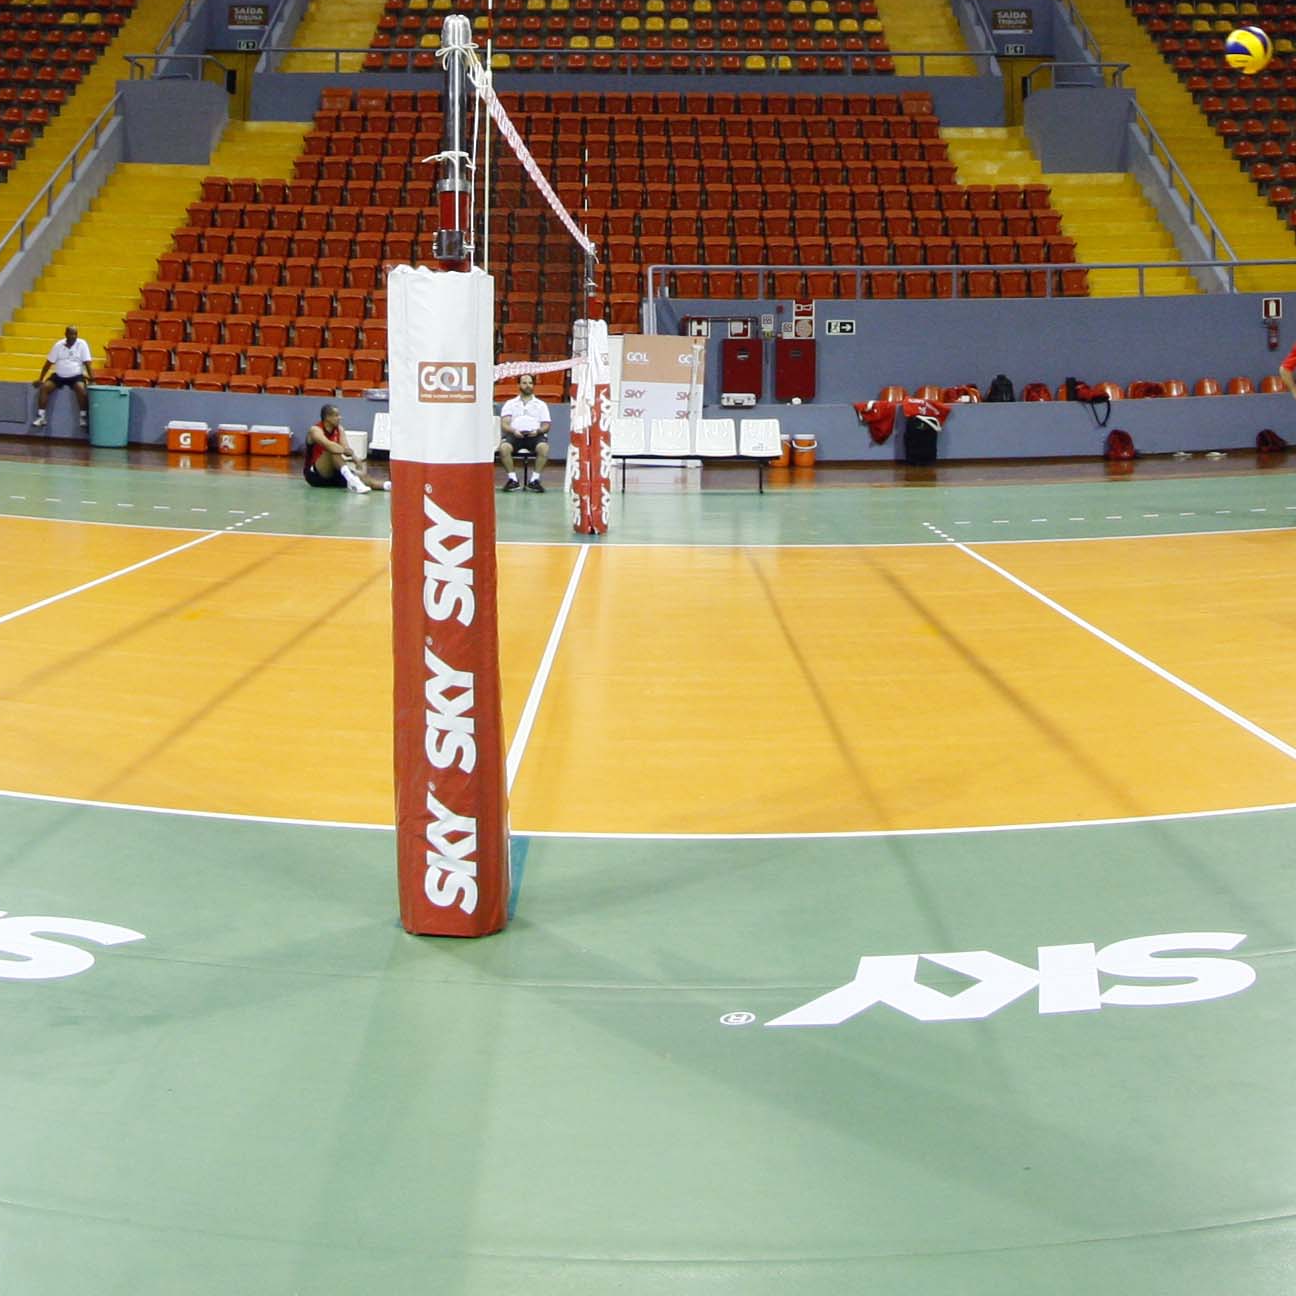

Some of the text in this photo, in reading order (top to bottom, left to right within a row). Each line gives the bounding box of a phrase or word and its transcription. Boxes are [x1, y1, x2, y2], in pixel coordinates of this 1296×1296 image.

[626, 352, 649, 363] GOL
[421, 366, 474, 392] GOL
[624, 389, 646, 399] SKY
[623, 408, 645, 418] SKY
[179, 433, 191, 444] G
[423, 495, 475, 627] SKY
[424, 645, 476, 774] SKY
[425, 791, 478, 915] SKY
[764, 931, 1256, 1025] SKY
